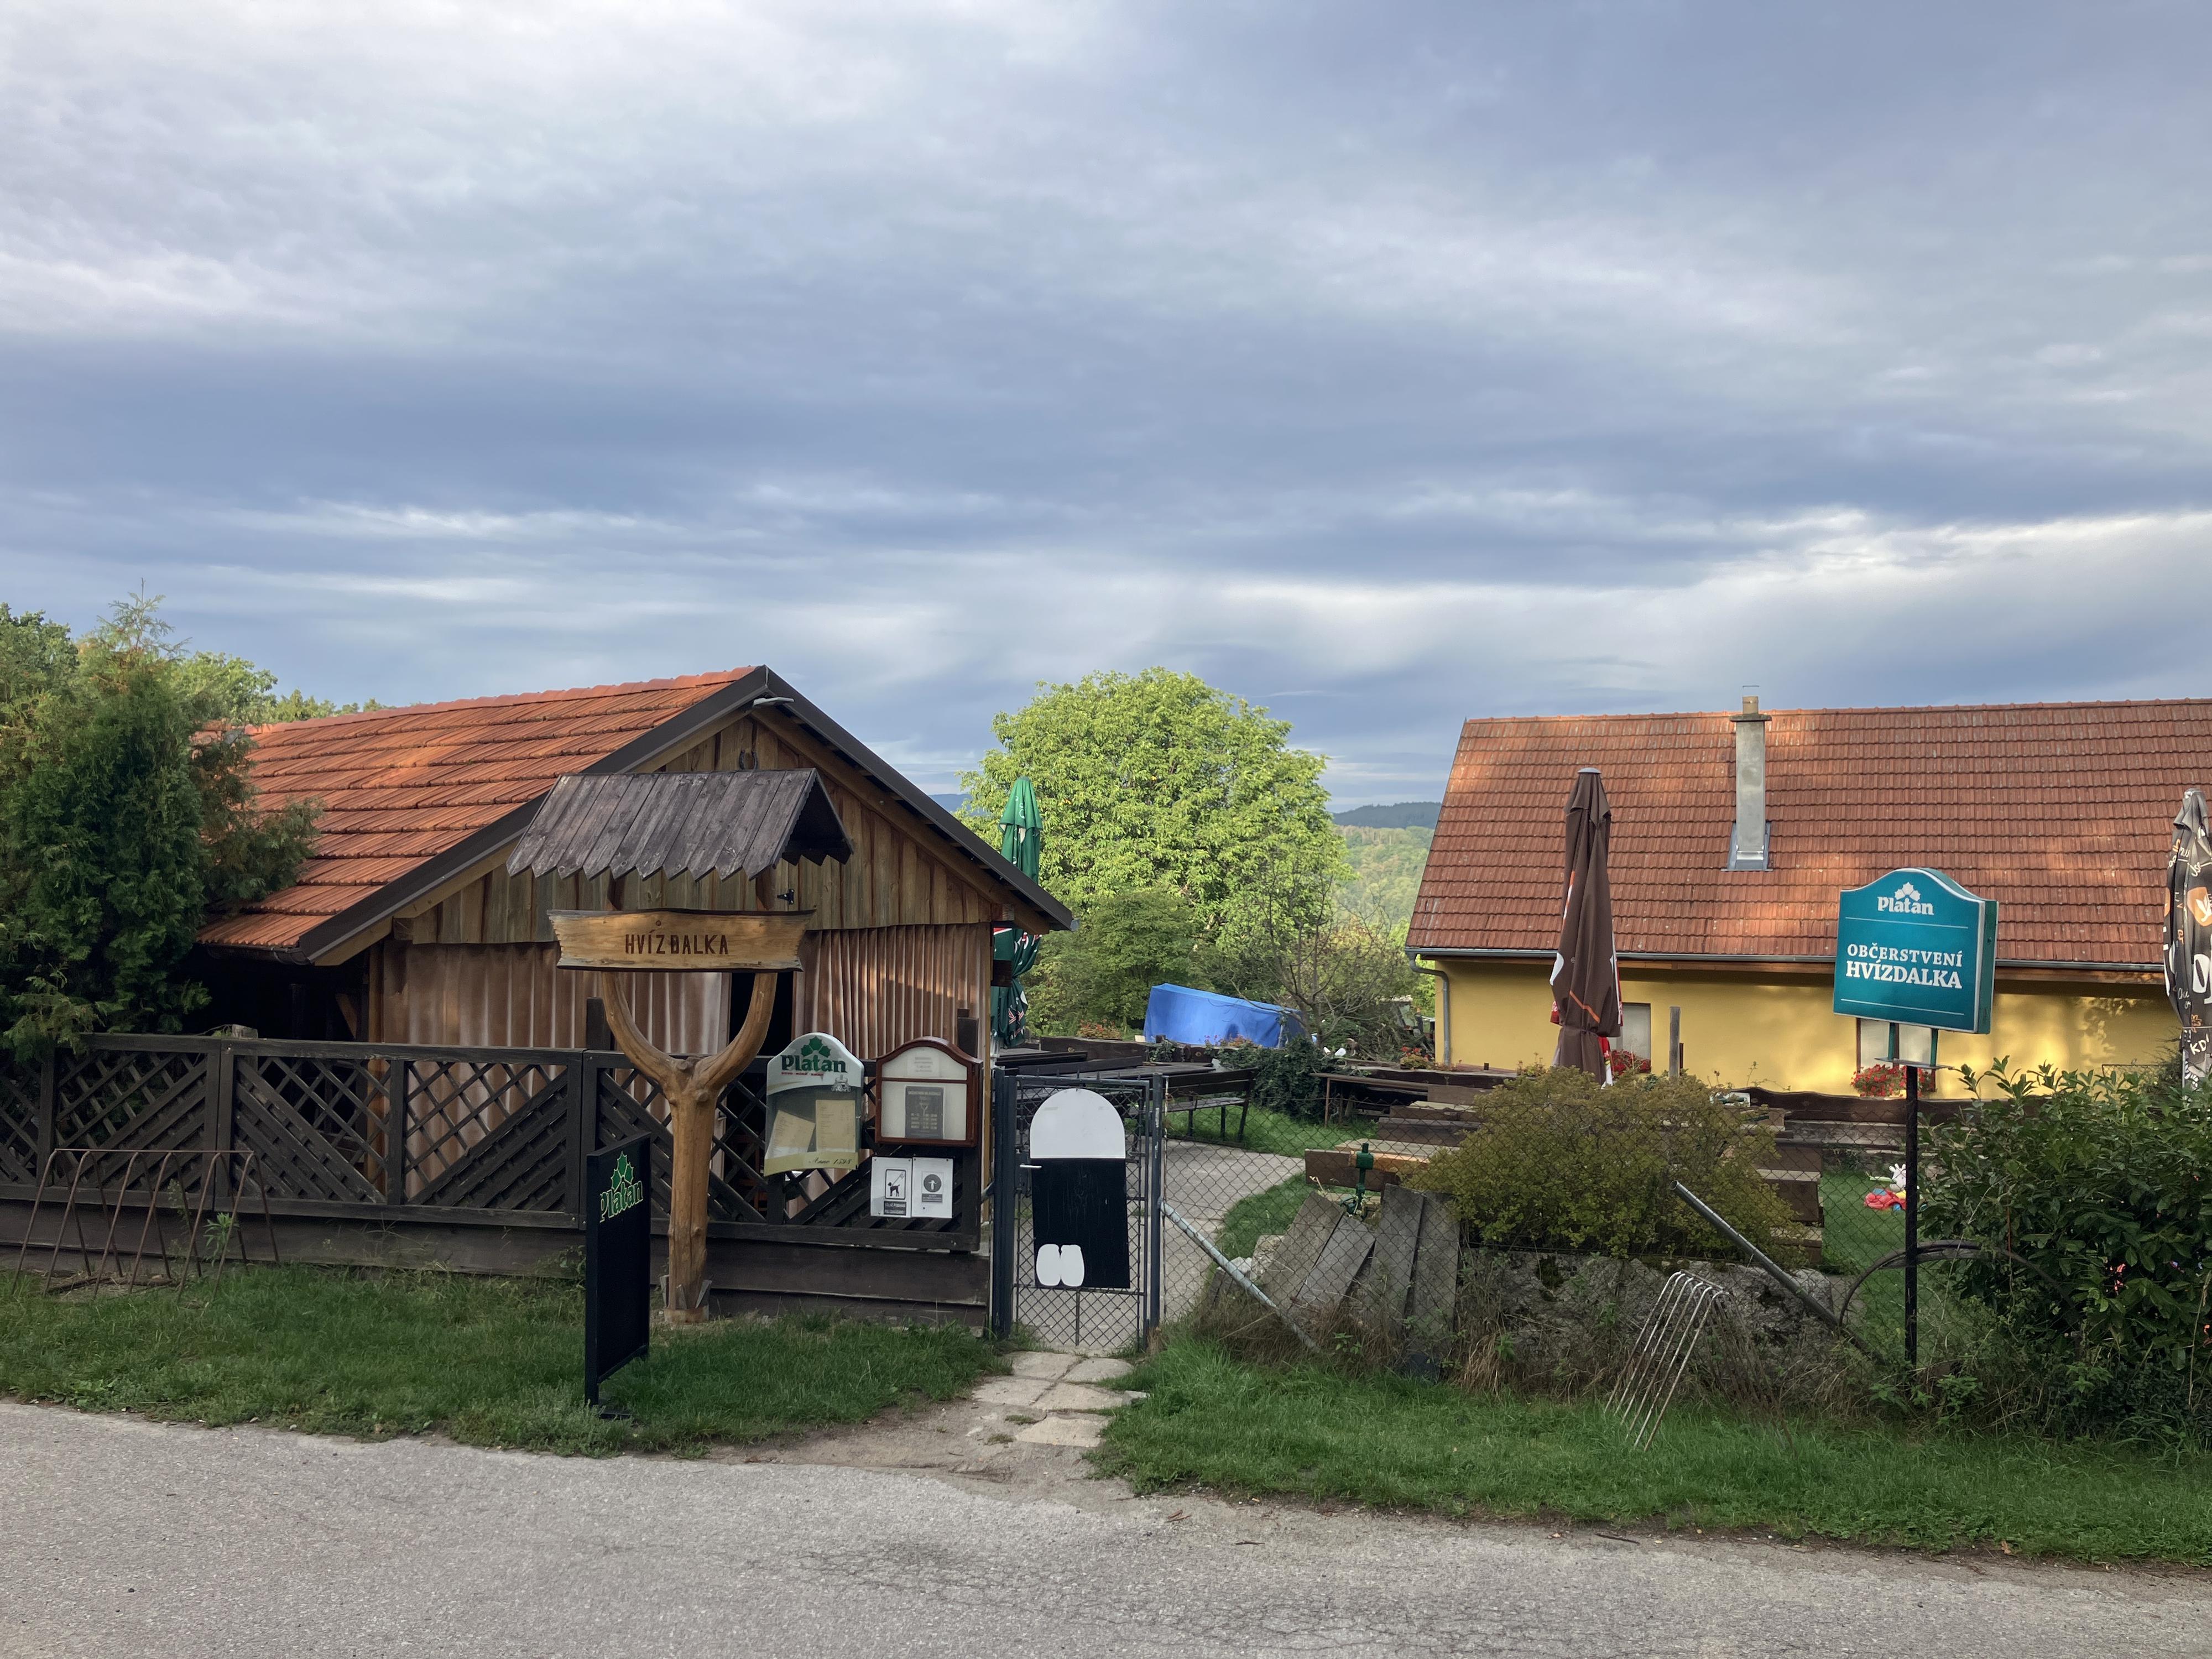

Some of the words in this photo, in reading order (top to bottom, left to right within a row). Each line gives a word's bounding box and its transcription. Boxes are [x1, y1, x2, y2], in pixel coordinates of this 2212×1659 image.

[1877, 896, 1934, 915] Platan
[625, 929, 728, 954] HVÍZDALKA
[1847, 942, 1963, 967] OBČERSTVENÍ
[1846, 959, 1962, 989] HVÍZDALKA
[780, 1054, 848, 1073] Platan
[599, 1180, 644, 1223] Platan
